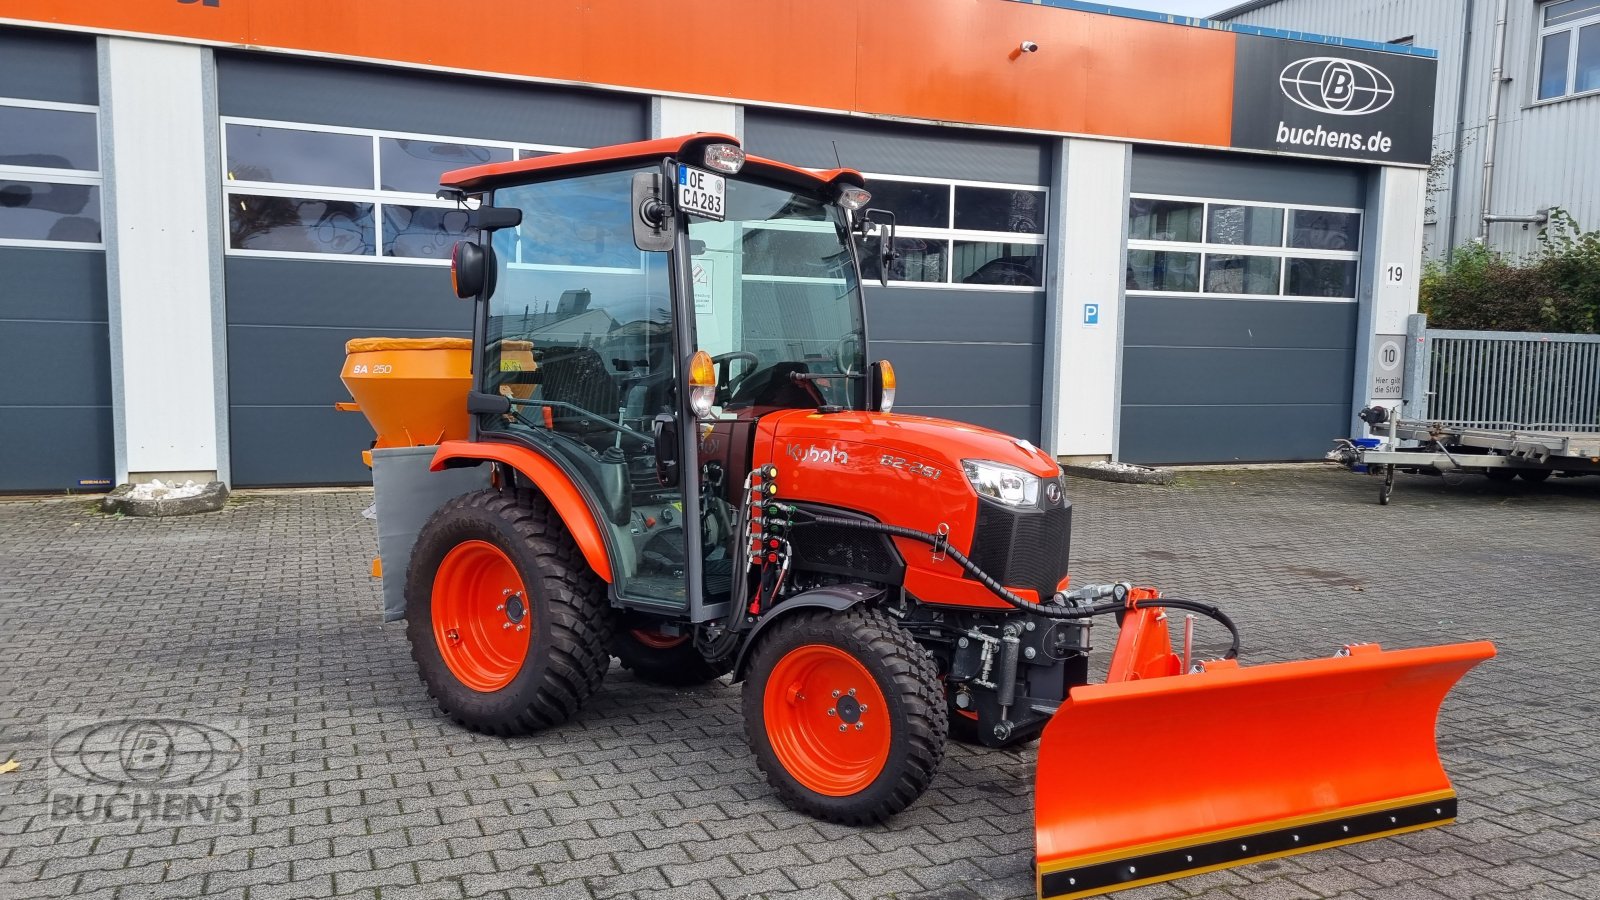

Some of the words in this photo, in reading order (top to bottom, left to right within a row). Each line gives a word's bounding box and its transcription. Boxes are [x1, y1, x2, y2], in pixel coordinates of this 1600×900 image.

[1276, 121, 1392, 153] buchens.de
[689, 171, 705, 191] OE
[1387, 266, 1403, 282] 19
[1085, 305, 1097, 322] P
[1384, 349, 1396, 363] 10
[372, 364, 392, 374] 250
[1375, 376, 1389, 384] Hier
[1374, 385, 1384, 393] die
[786, 443, 849, 465] Kubota
[879, 454, 942, 480] B2-261
